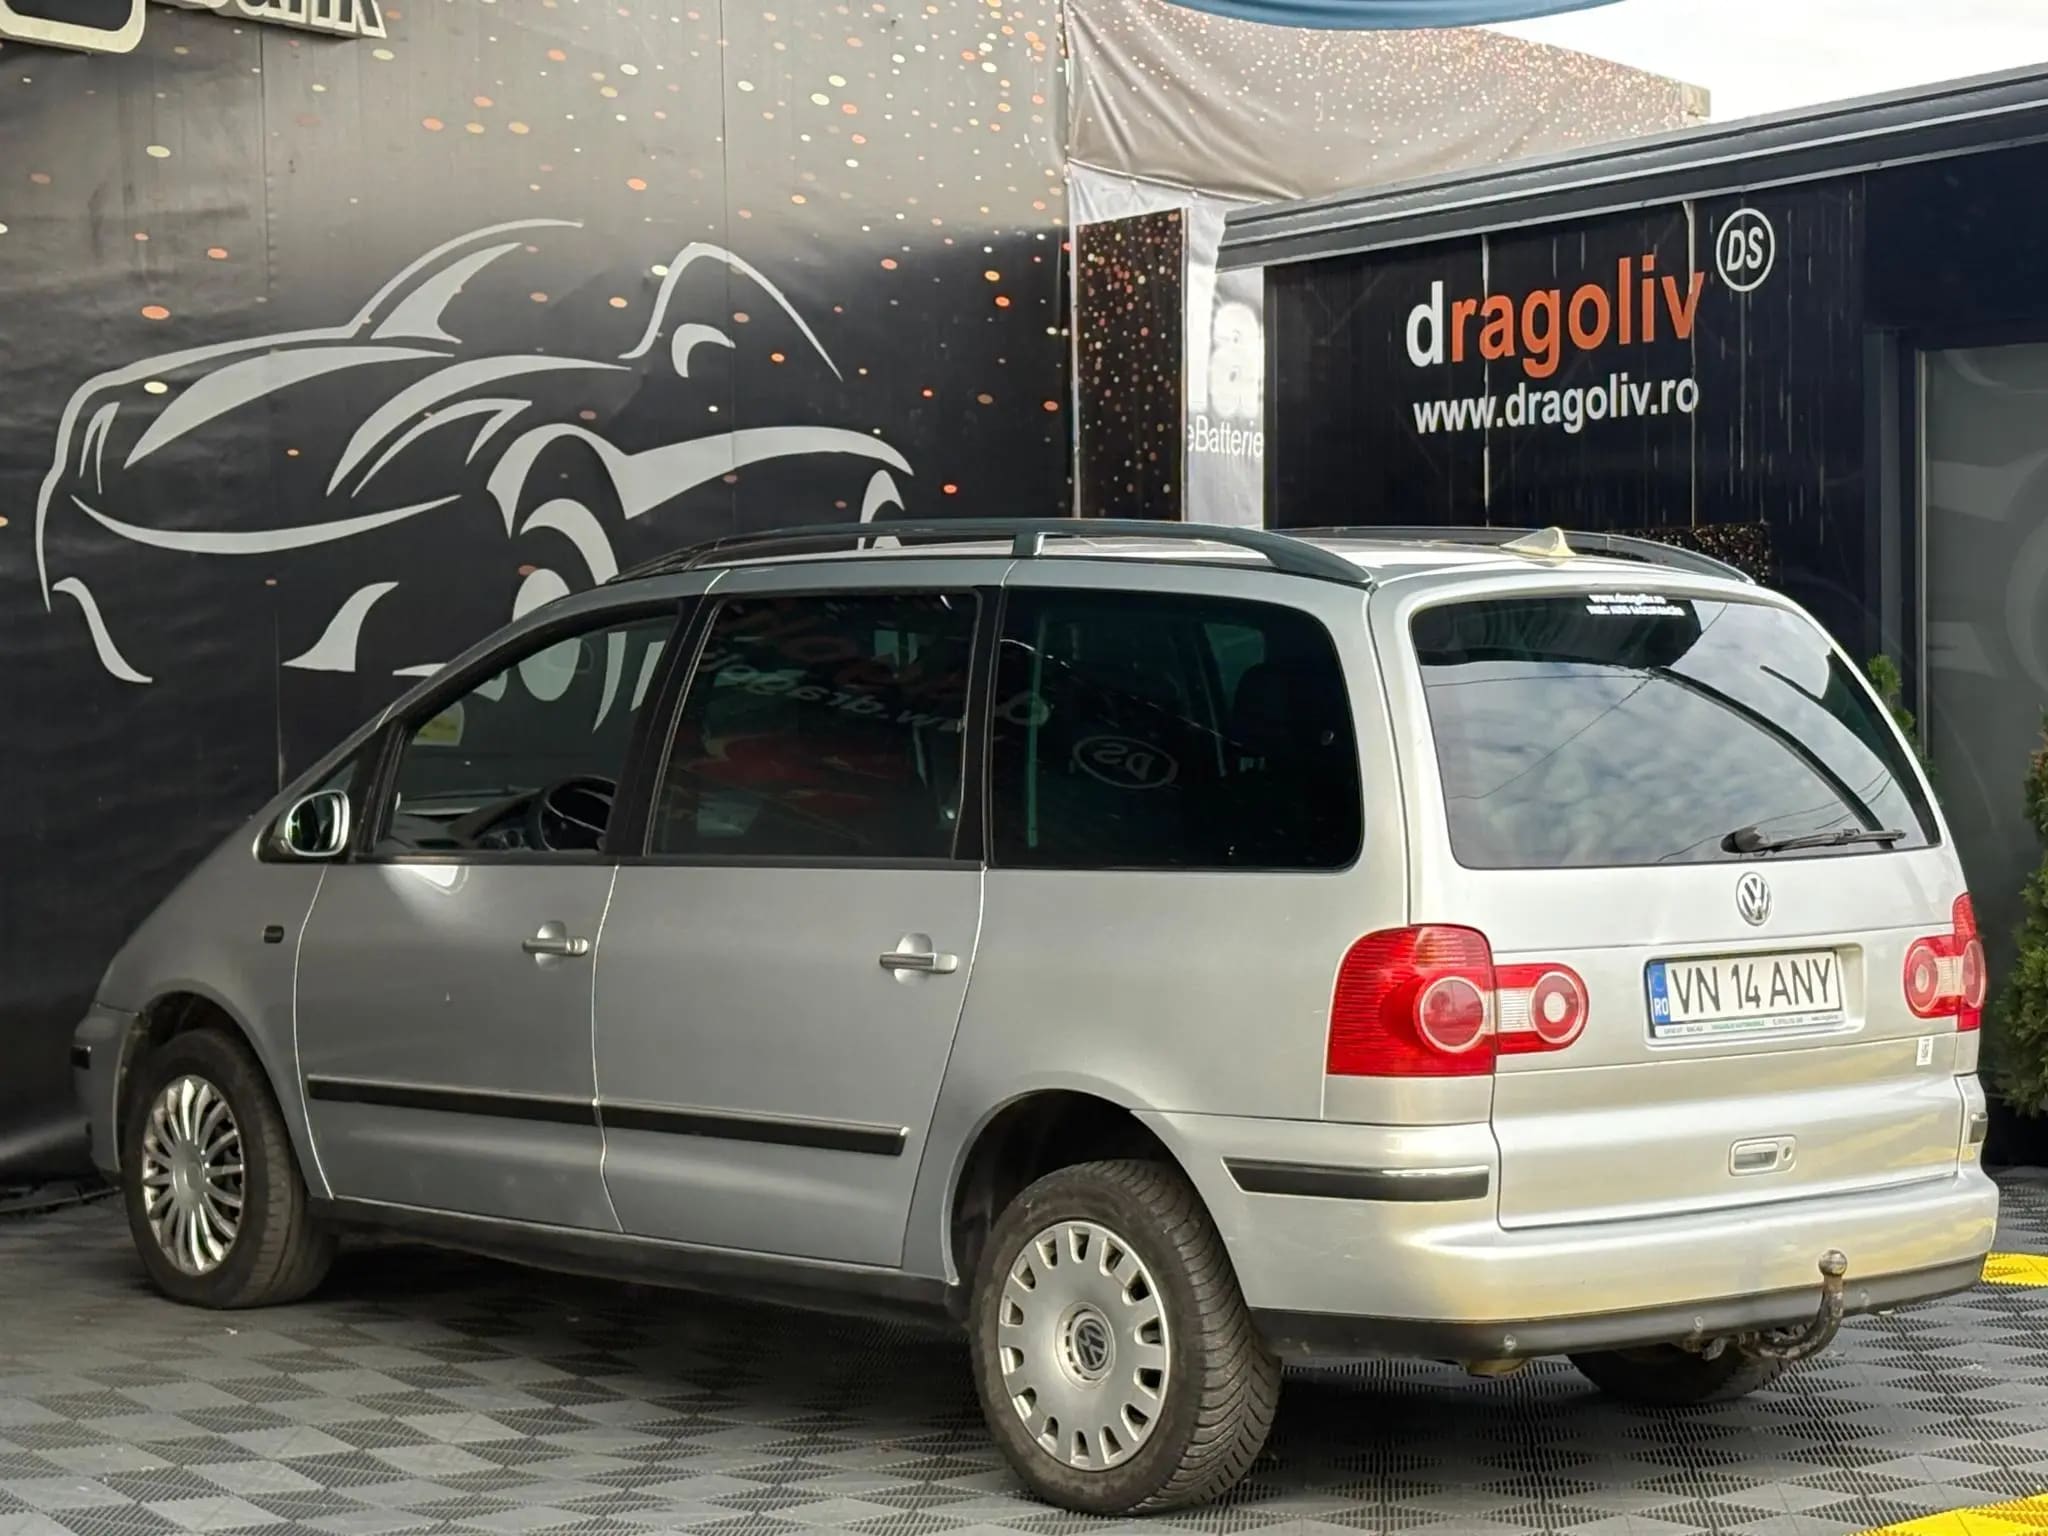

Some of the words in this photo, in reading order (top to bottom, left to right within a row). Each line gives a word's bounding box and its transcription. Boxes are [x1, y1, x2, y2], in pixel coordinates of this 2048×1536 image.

[1726, 225, 1764, 272] DS
[1406, 253, 1706, 379] dragoliv
[1413, 372, 1700, 434] www.dragoliv.ro
[1654, 998, 1669, 1017] RO
[1671, 965, 1721, 1015] VN
[1731, 963, 1761, 1010] 14
[1769, 957, 1831, 1007] ANY
